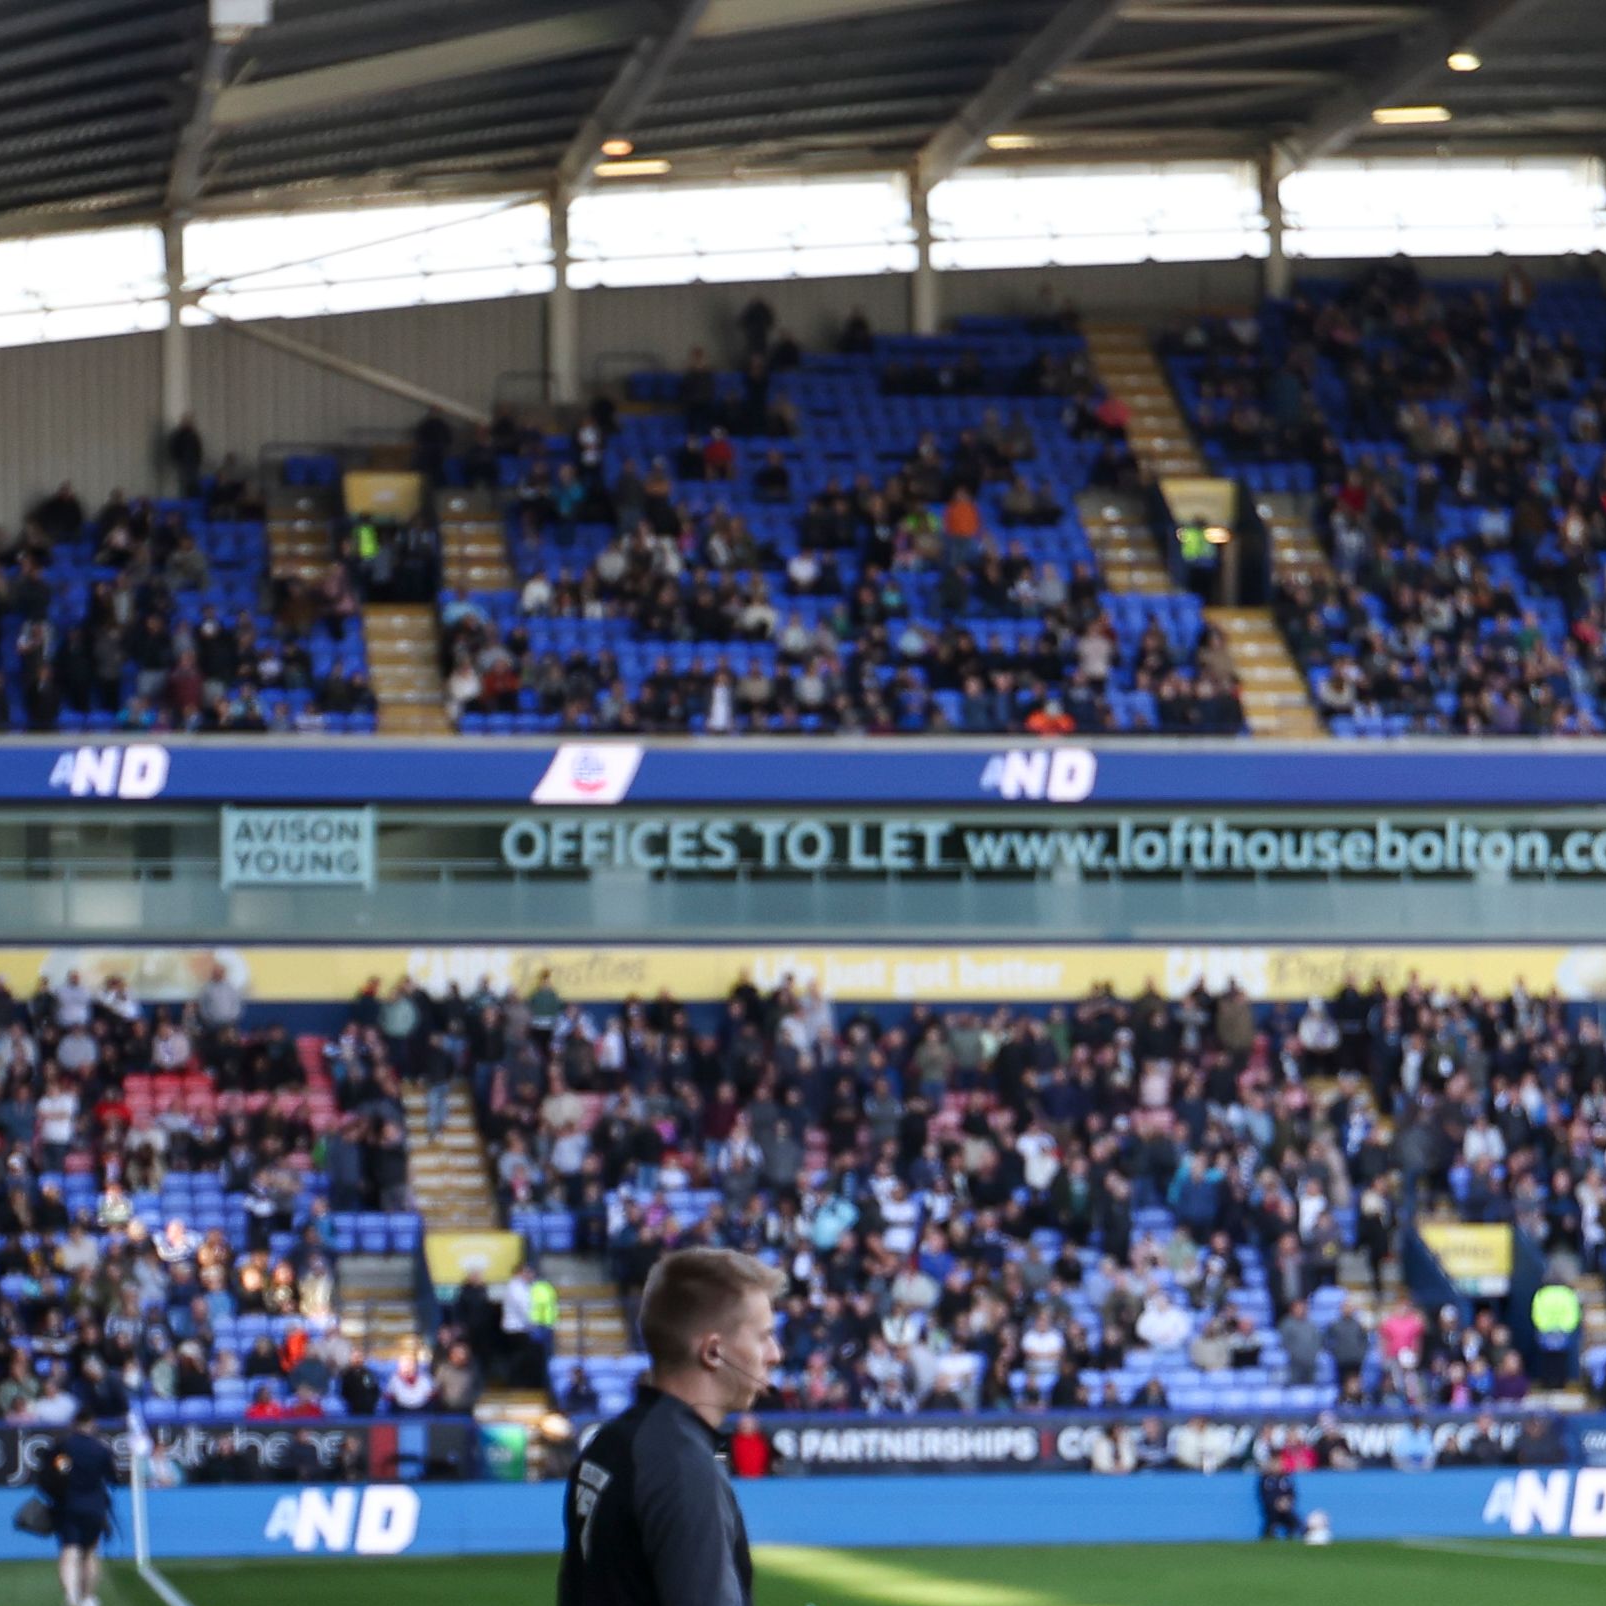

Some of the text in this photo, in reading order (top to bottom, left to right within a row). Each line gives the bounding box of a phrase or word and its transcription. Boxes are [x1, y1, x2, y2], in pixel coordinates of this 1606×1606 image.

[233, 819, 361, 846] AVISON
[500, 820, 737, 870] OFFICES
[751, 820, 833, 870] TO
[849, 819, 951, 870] LET
[233, 848, 361, 877] YOUNG
[799, 1426, 1040, 1462] PARTNERSHIPS
